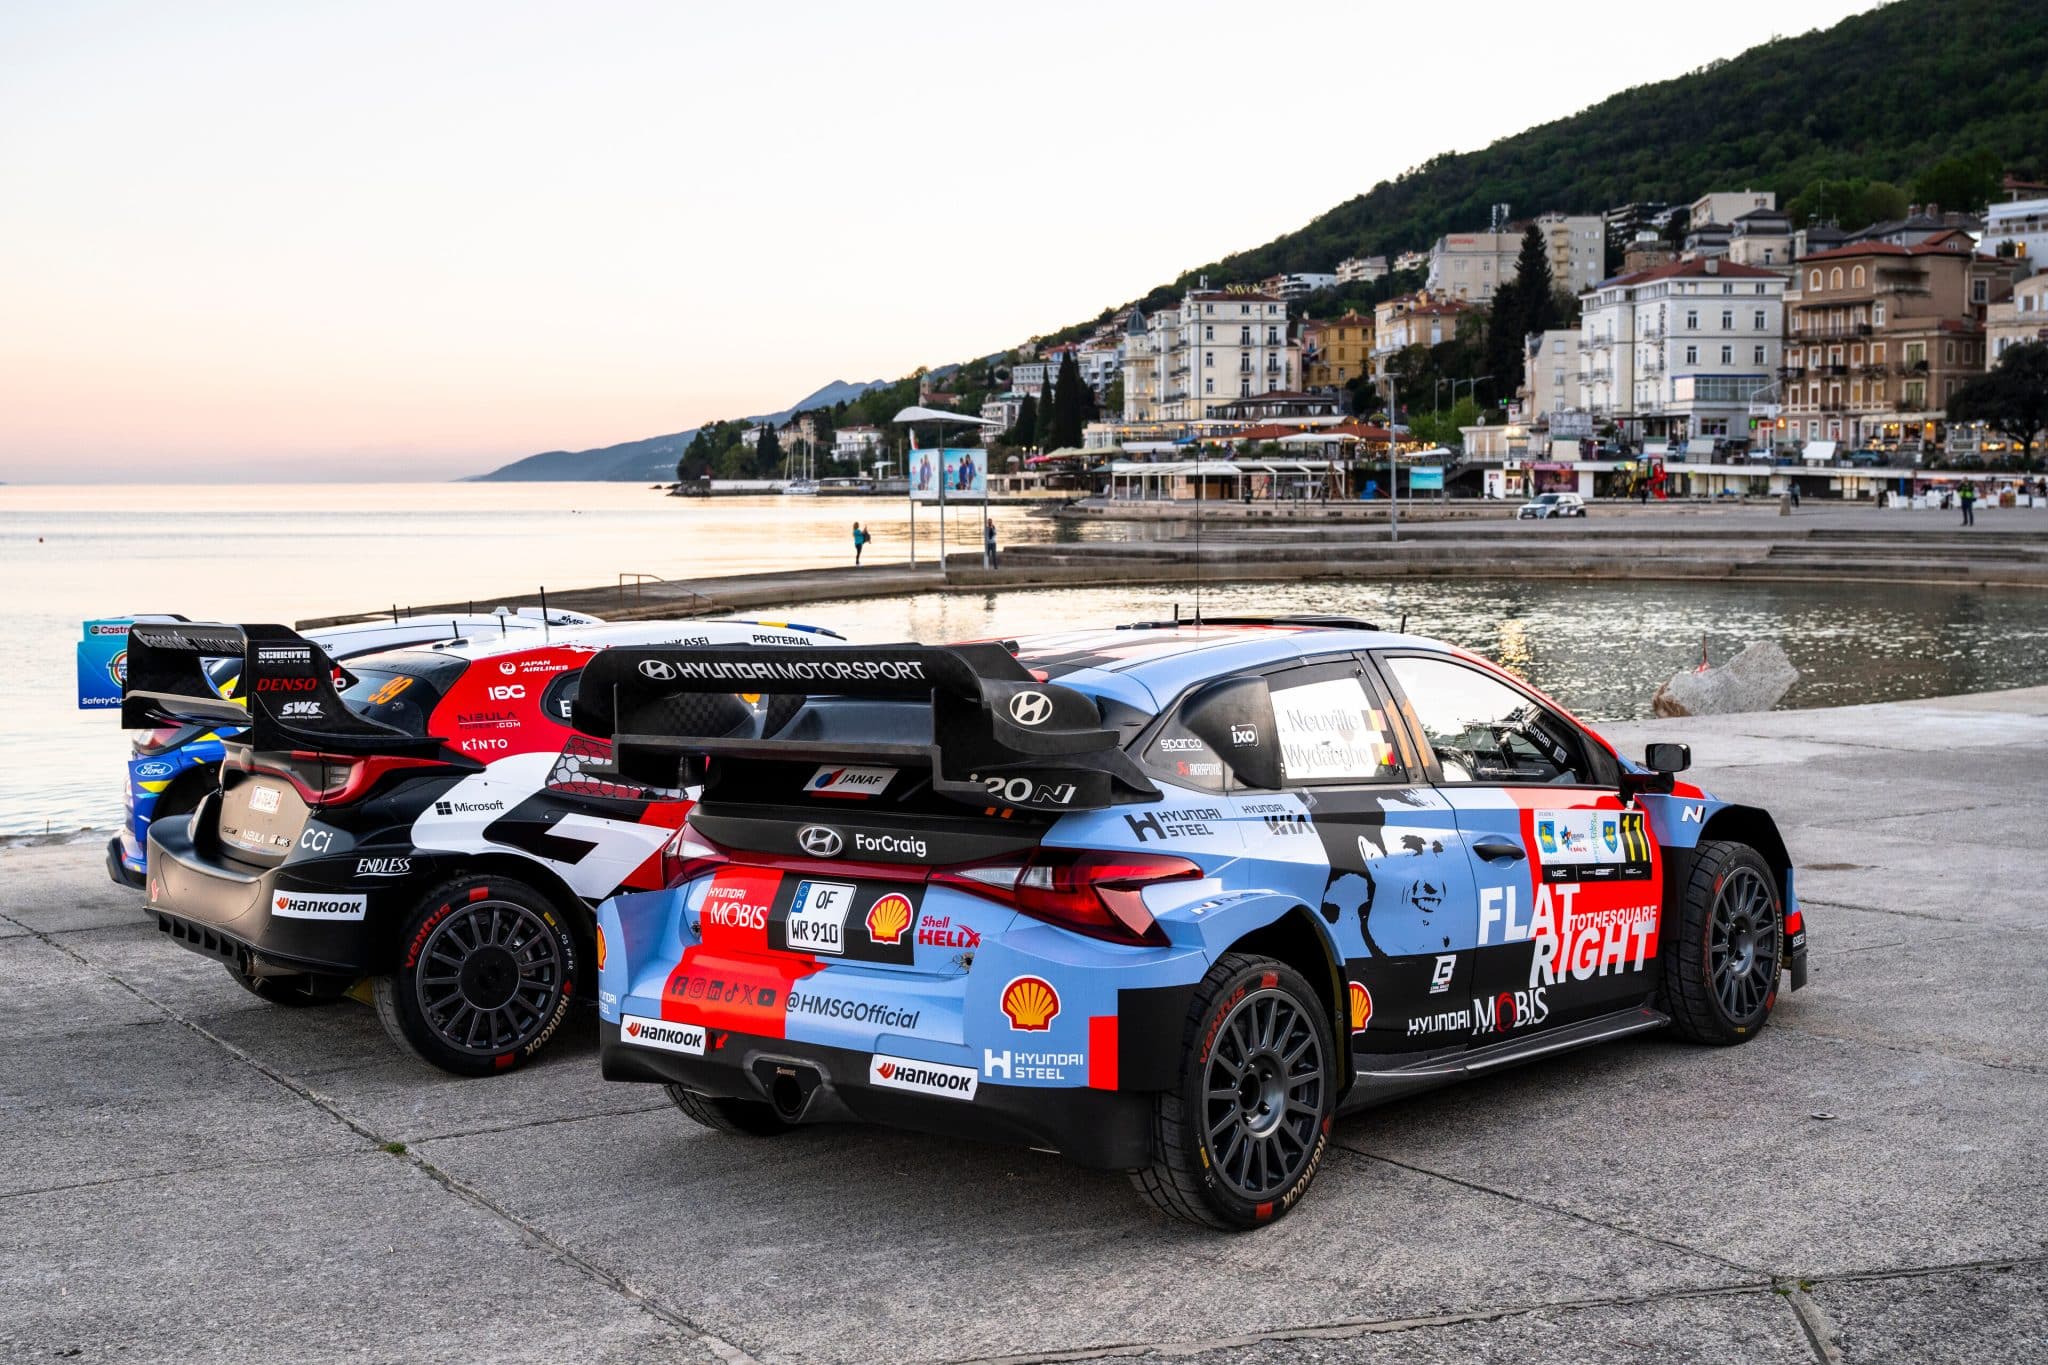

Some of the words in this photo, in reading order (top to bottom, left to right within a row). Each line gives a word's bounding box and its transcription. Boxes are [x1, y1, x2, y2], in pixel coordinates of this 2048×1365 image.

[1225, 281, 1262, 295] SAVOY
[752, 634, 814, 646] PROTERIAL
[258, 651, 310, 659] SCHROTH
[522, 664, 569, 672] AIRLINES
[675, 662, 779, 679] HYUNDAI
[776, 661, 926, 679] MOTORSPORT
[256, 677, 318, 692] DENSO
[281, 701, 323, 715] SWS
[1287, 709, 1358, 733] Neuville
[1231, 725, 1256, 744] ixo
[462, 738, 508, 750] KINTO
[1161, 738, 1203, 752] sparco
[1283, 742, 1368, 773] Wydaeghe
[140, 764, 167, 775] Ford
[839, 774, 883, 785] JANAF
[454, 800, 504, 813] Microsoft
[1242, 803, 1286, 814] HYUNDAI
[1156, 808, 1223, 824] HYUNDAI
[1165, 823, 1215, 838] STEEL
[855, 833, 927, 858] ForCraig
[1623, 815, 1648, 862] 11
[356, 857, 412, 875] ENDLESS
[708, 887, 746, 900] HYUNDAI
[815, 890, 838, 910] OF
[710, 901, 768, 930] MOBIS
[921, 915, 950, 928] Shell
[1478, 882, 1581, 946] FLAT
[1571, 905, 1658, 932] TOTHESQUARE
[791, 919, 809, 941] WR
[811, 922, 838, 944] 910
[918, 923, 982, 949] HELIX
[1529, 918, 1657, 989] RIGHT
[785, 991, 920, 1030] @HMSGOfficial
[1407, 1009, 1471, 1036] HYUNDAI
[1472, 986, 1549, 1036] MOBIS
[1015, 1052, 1084, 1066] HYUNDAI
[1015, 1067, 1065, 1080] STEEL
